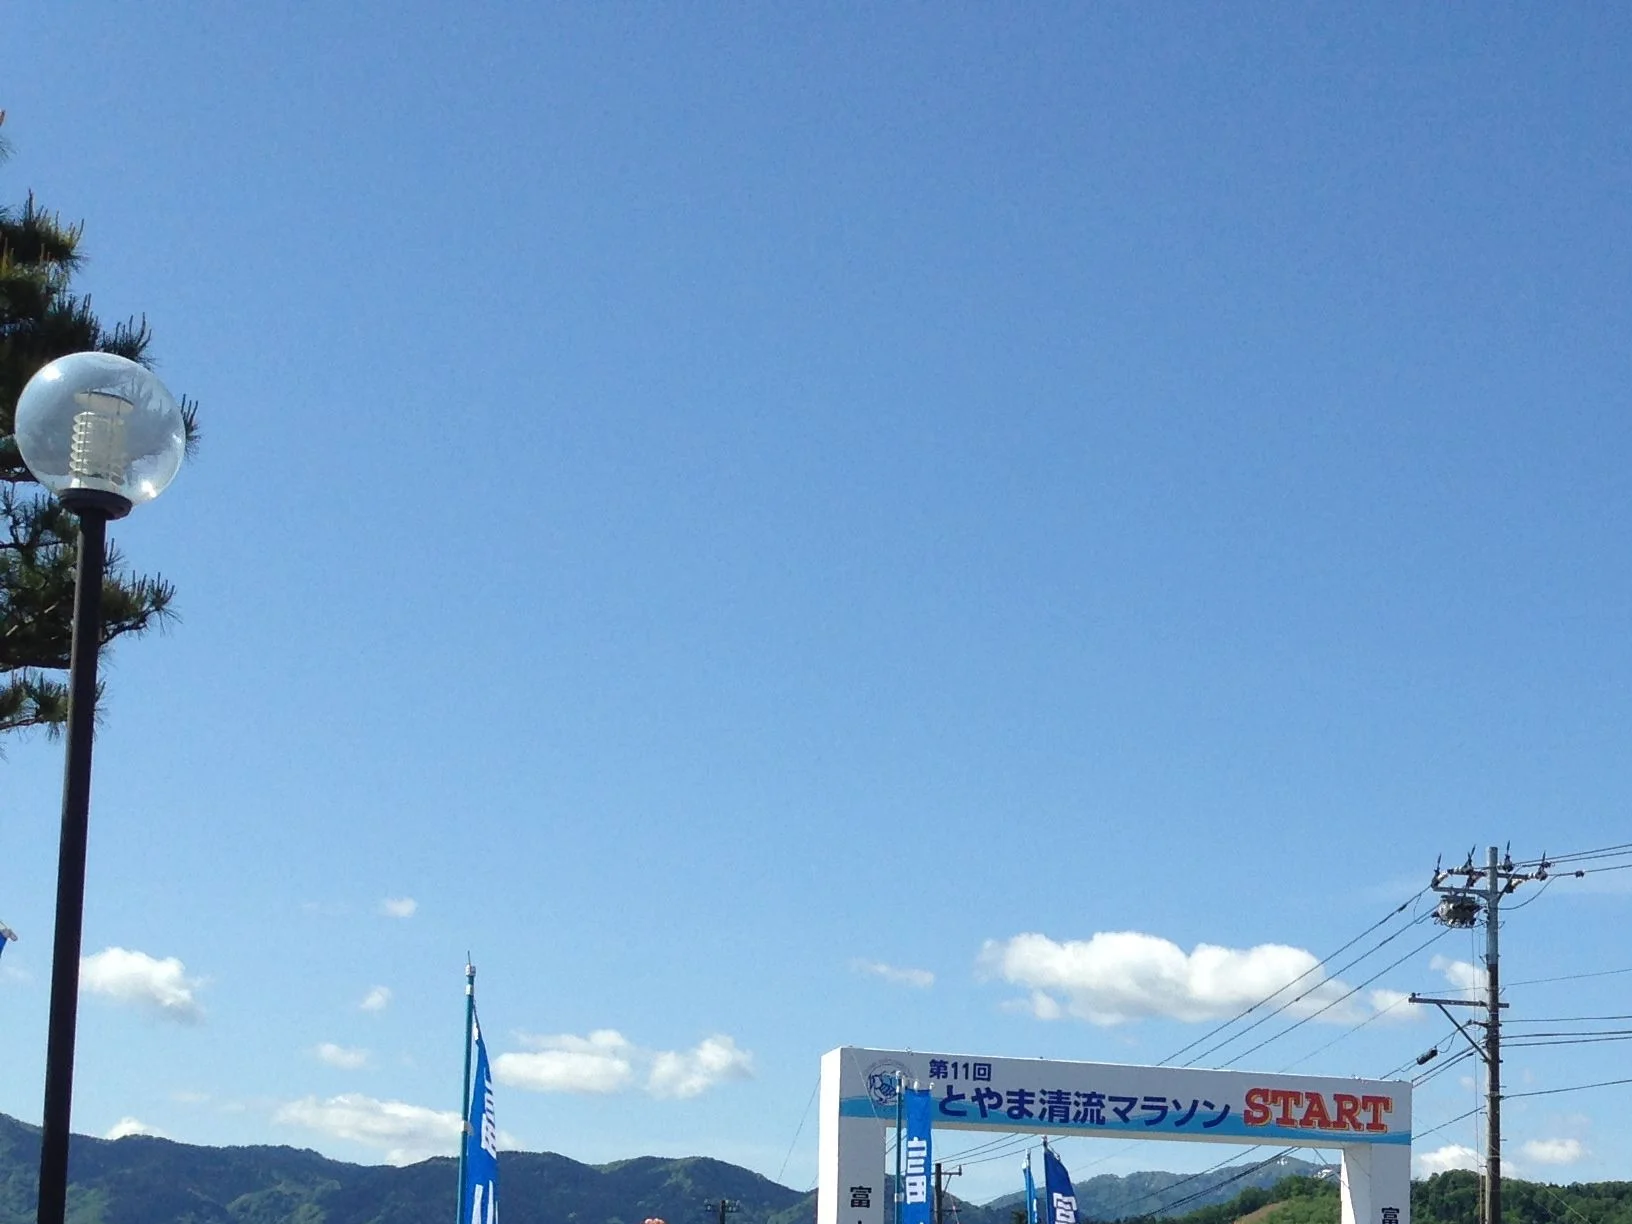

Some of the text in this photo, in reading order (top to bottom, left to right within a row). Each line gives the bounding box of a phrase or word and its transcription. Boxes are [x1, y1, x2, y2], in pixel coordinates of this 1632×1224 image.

[929, 1059, 992, 1082] 第11回
[938, 1085, 1231, 1129] とやま清流マラソン
[1243, 1087, 1393, 1133] START
